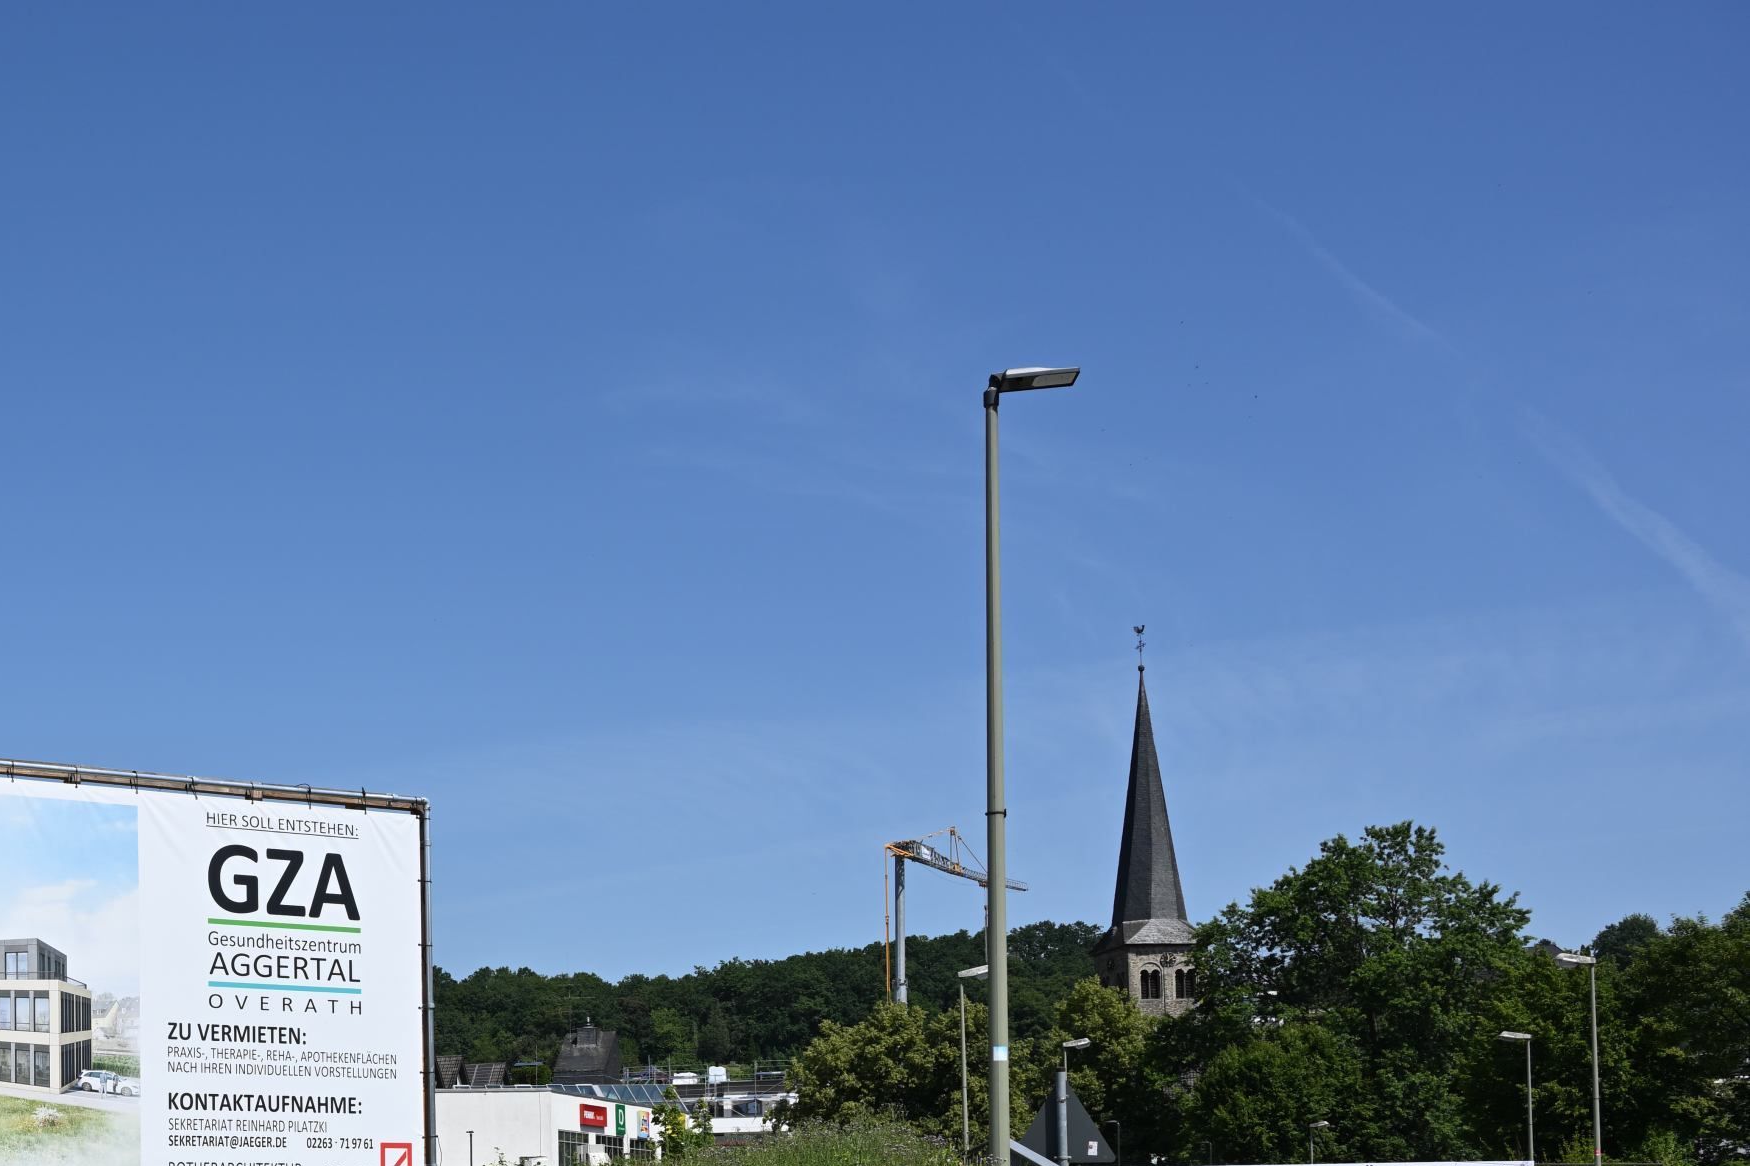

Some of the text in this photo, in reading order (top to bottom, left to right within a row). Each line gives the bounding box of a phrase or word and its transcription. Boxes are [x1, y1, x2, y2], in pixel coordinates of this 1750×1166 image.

[206, 812, 359, 837] HIER SOLL ENTSTEHEN:
[208, 844, 361, 920] GZA
[208, 930, 361, 954] Gesundheitszentrum
[209, 951, 361, 983] AGGERTAL
[209, 992, 362, 1015] OVERATH
[168, 1022, 306, 1045] ZU VERMIETEN:
[301, 1051, 396, 1064] APOTHEKENFLÄCHEN
[168, 1061, 396, 1079] NACH IHREN INDIVIDUELLEN VORSTELLUNGEN
[168, 1092, 362, 1114] KONTAKTAUFNAHME:
[169, 1118, 327, 1133] SEKRETARIAT REINHARD PILATZKI
[169, 1135, 287, 1149] SEKRETARIAT@JAEGER.DE
[307, 1137, 332, 1149] 02263
